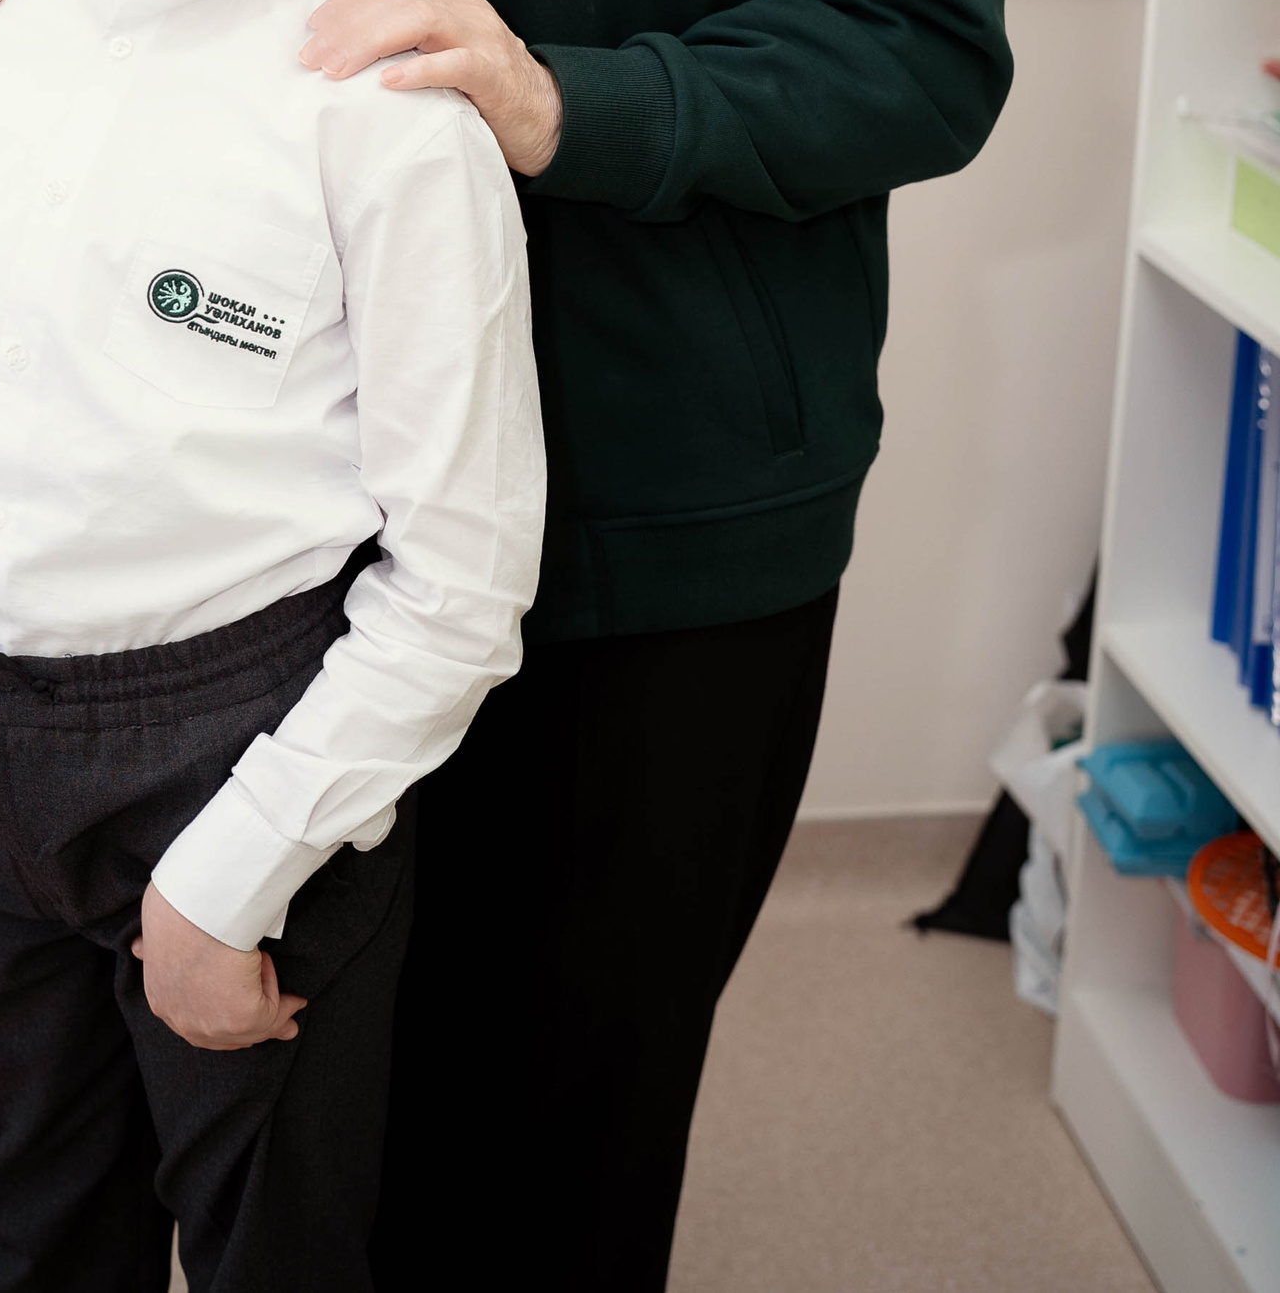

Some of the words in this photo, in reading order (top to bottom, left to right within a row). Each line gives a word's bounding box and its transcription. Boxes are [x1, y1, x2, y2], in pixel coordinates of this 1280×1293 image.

[204, 304, 283, 340] УӘЛИХАНОВ
[207, 292, 257, 317] ШОҚАН
[186, 320, 238, 348] атындағы
[239, 338, 277, 360] мектеп
